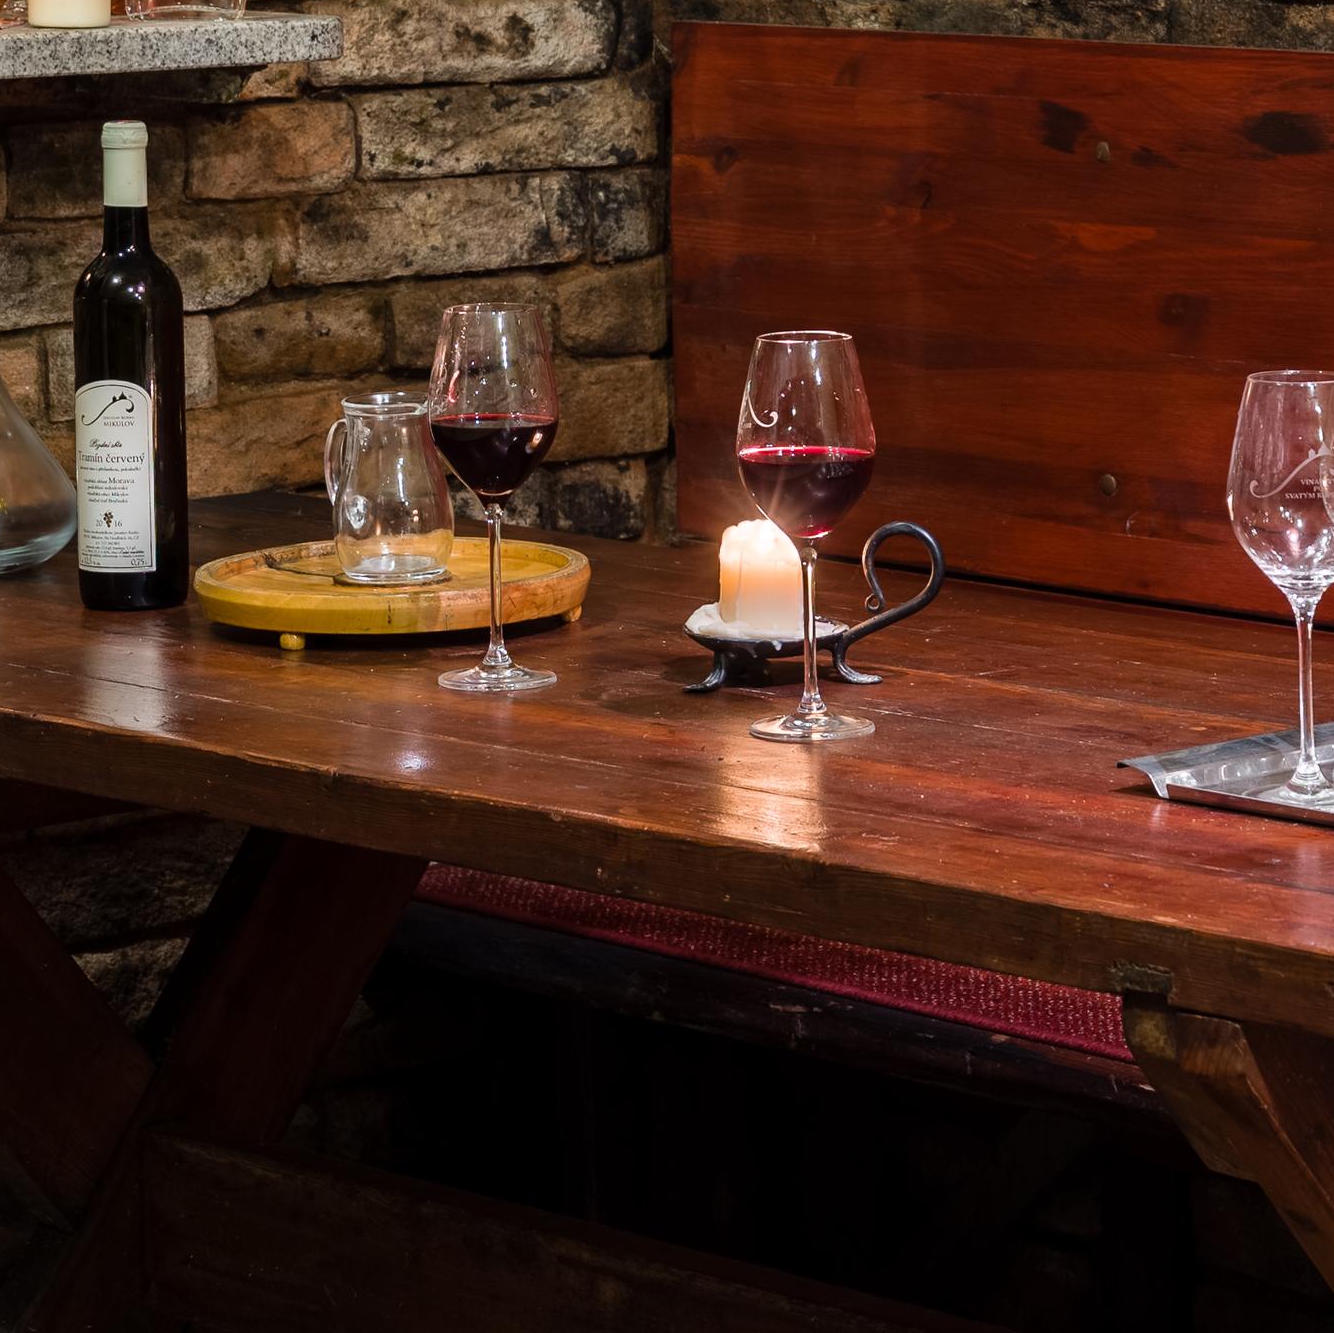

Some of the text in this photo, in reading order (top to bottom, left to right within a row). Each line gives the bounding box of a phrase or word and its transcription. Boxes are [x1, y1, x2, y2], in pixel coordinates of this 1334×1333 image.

[78, 451, 145, 464] Tramín červený
[130, 558, 145, 566] 0,75
